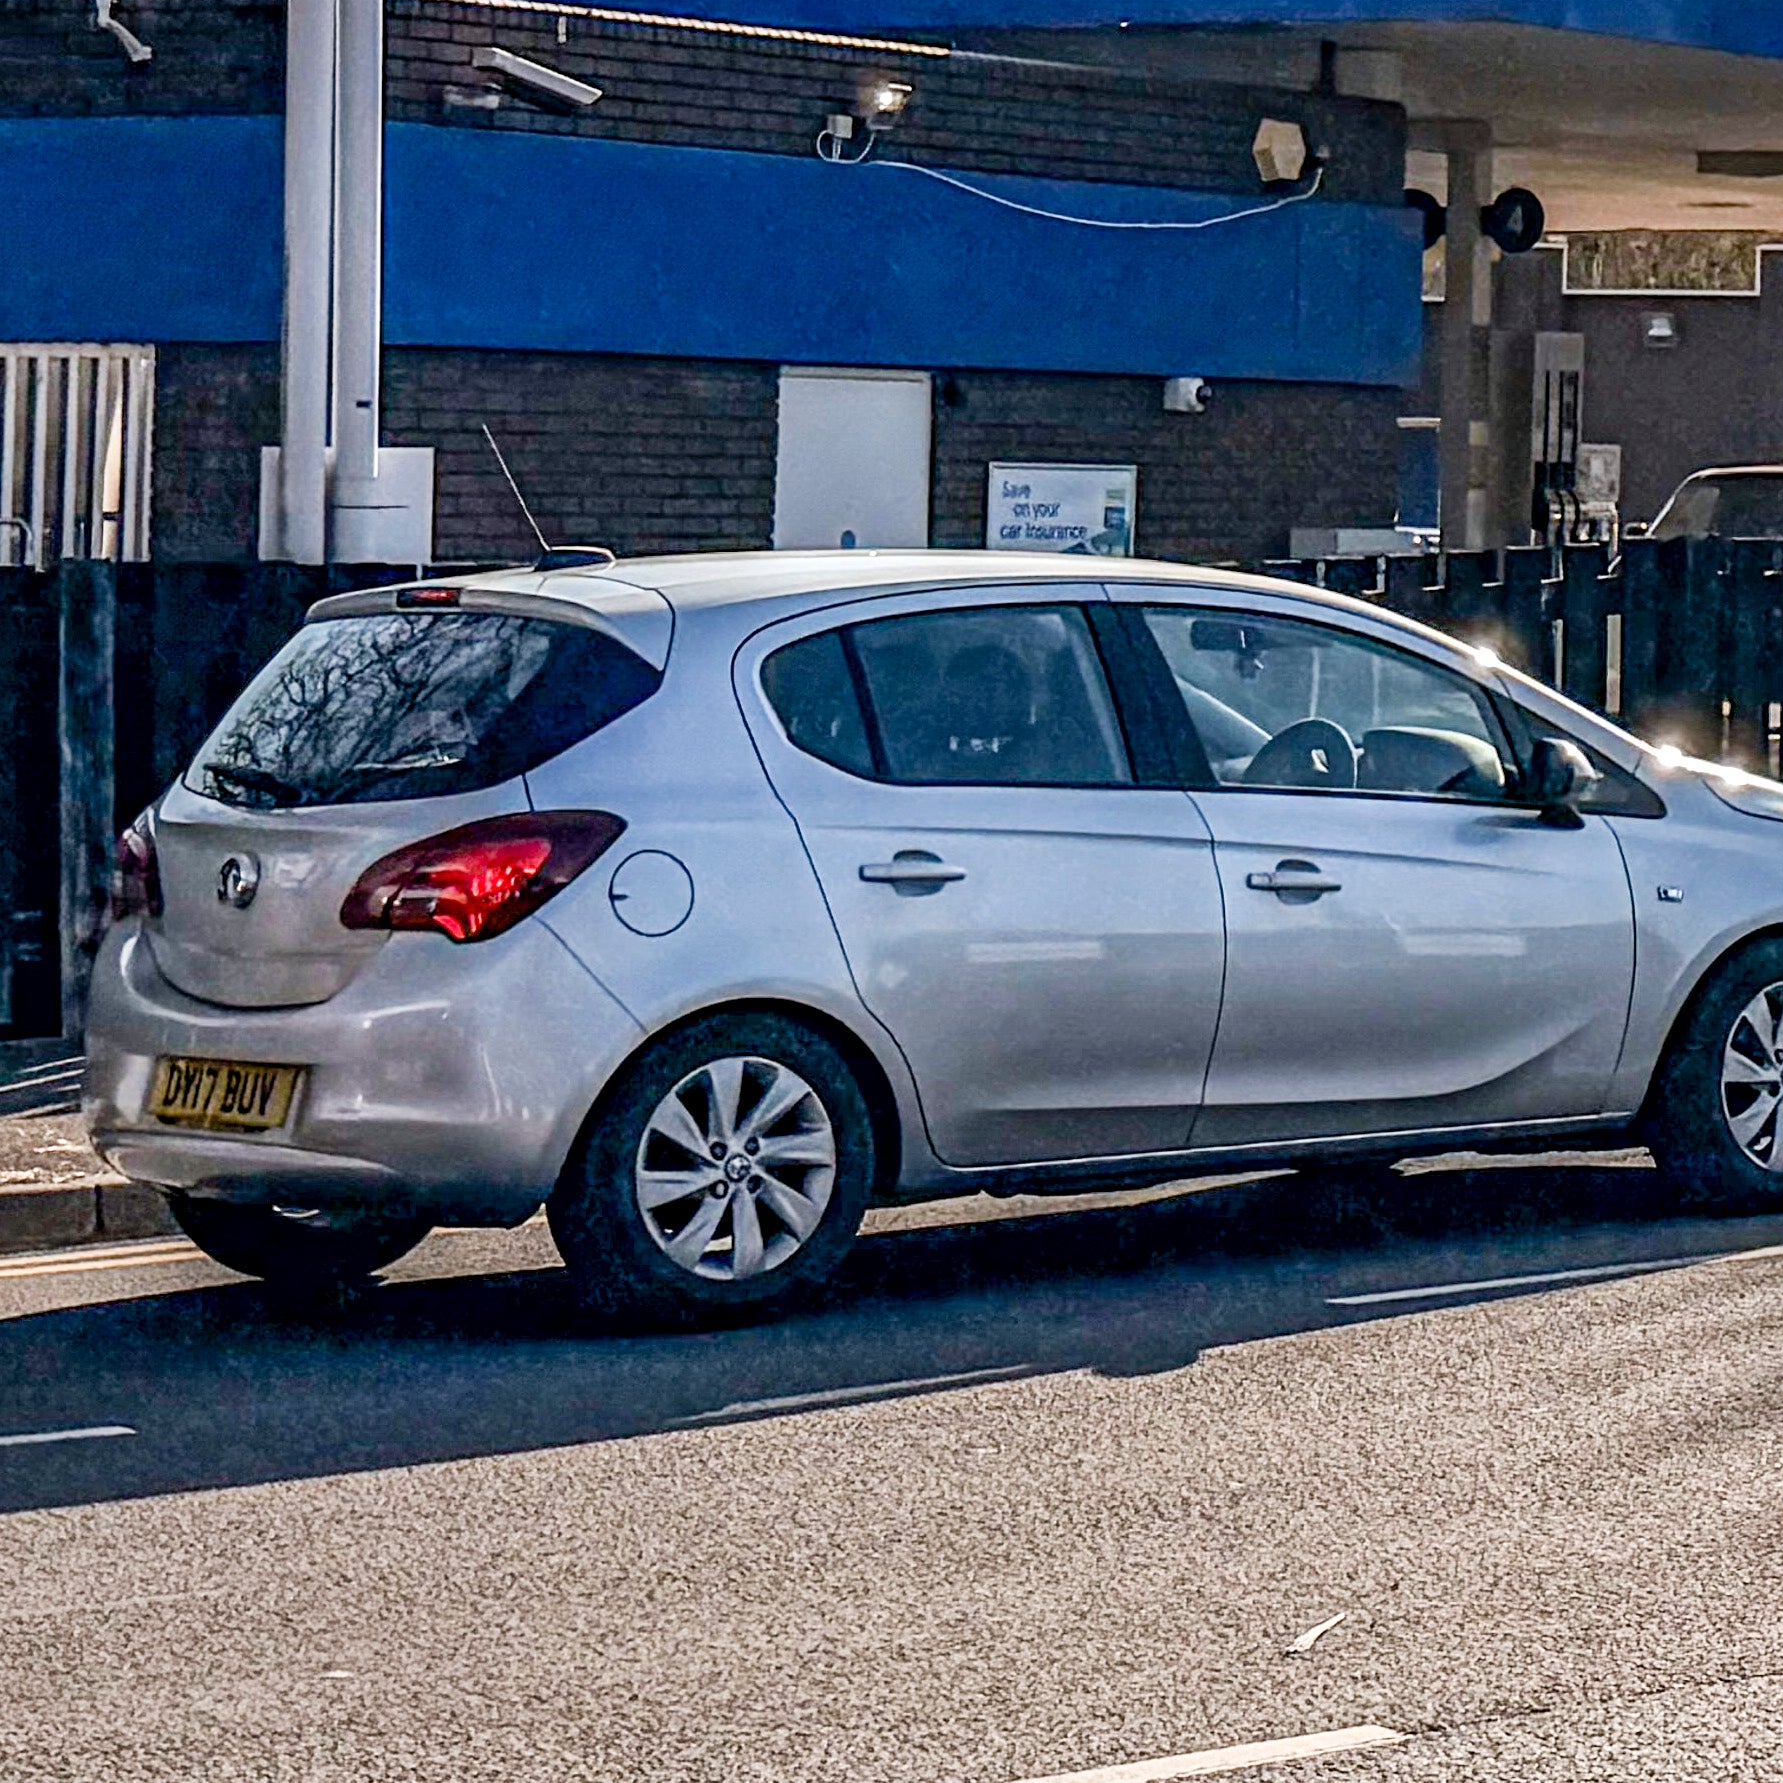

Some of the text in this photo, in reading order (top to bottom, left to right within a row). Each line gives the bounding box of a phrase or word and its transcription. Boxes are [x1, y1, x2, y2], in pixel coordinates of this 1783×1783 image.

[1505, 205, 1524, 234] 4
[1002, 481, 1031, 499] Save
[1033, 502, 1061, 521] your
[1000, 525, 1023, 540] car
[162, 1062, 277, 1116] DY17 BUV
